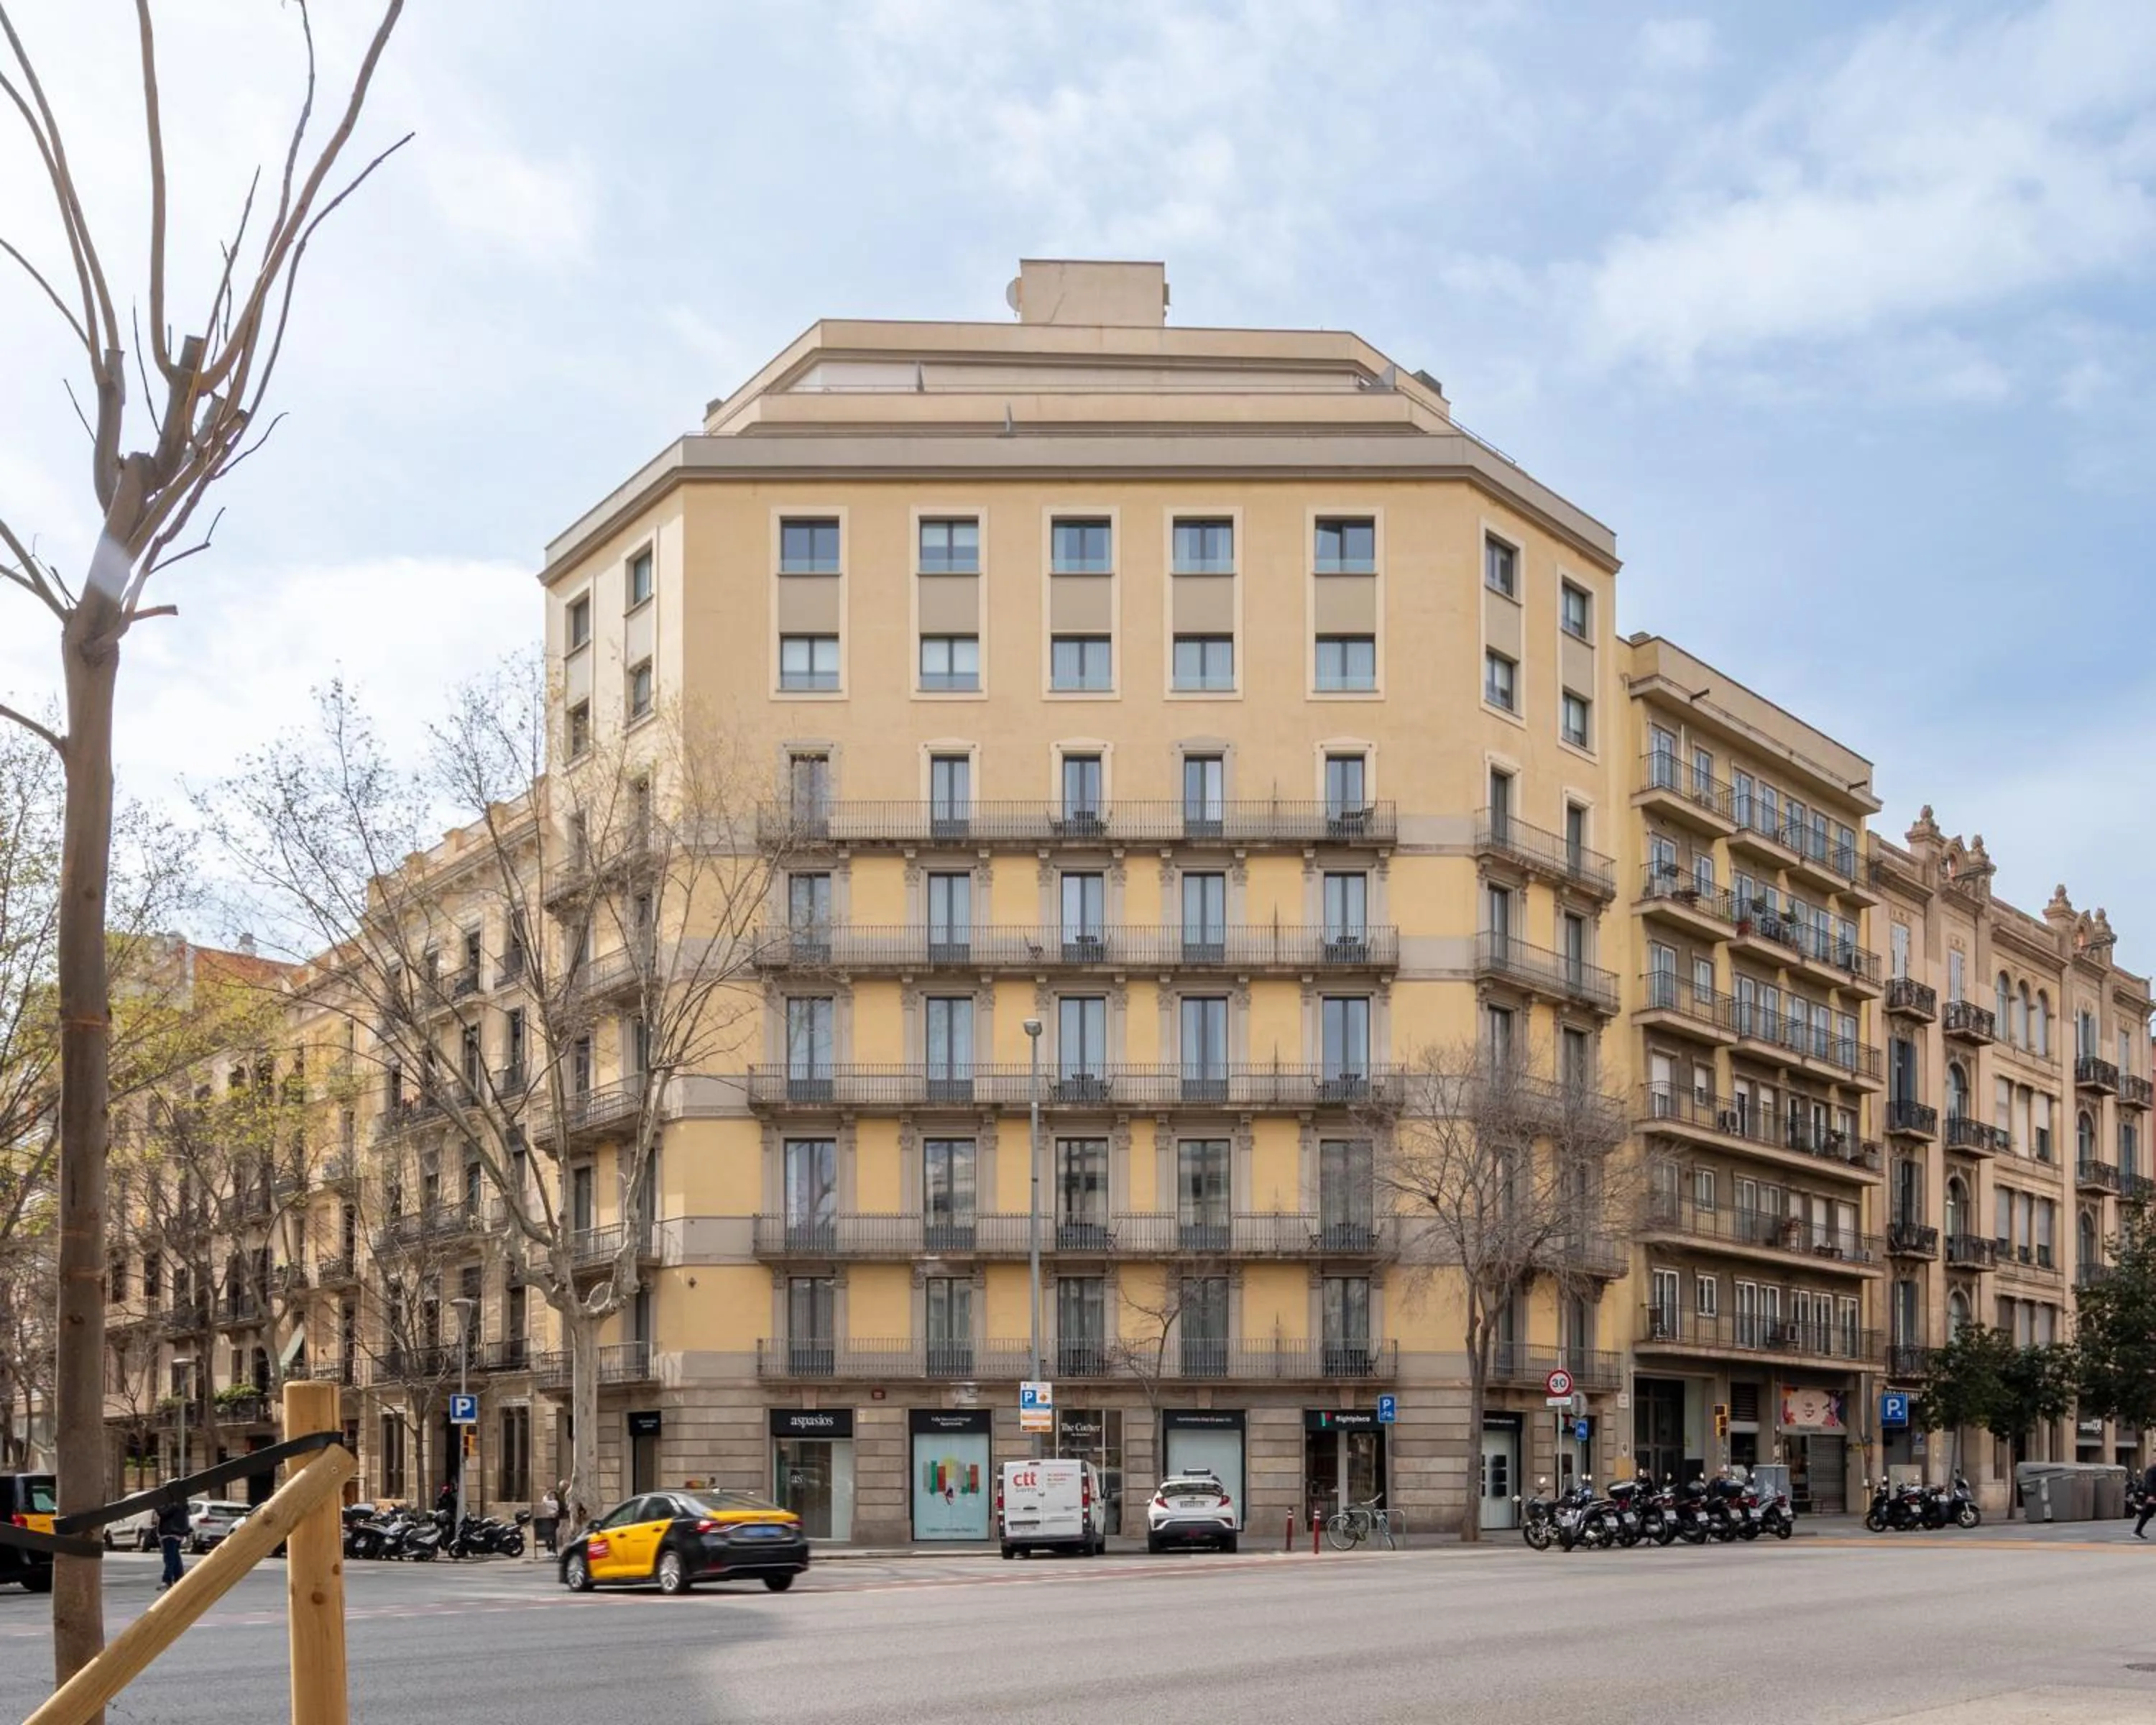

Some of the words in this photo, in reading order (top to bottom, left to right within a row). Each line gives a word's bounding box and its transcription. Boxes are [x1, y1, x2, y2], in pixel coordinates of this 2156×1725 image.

[1552, 1378, 1567, 1388] 30
[1024, 1391, 1033, 1402] P
[456, 1397, 472, 1417] P
[1383, 1399, 1392, 1410] P
[791, 1413, 834, 1429] aspasios
[1013, 1471, 1036, 1487] ctt
